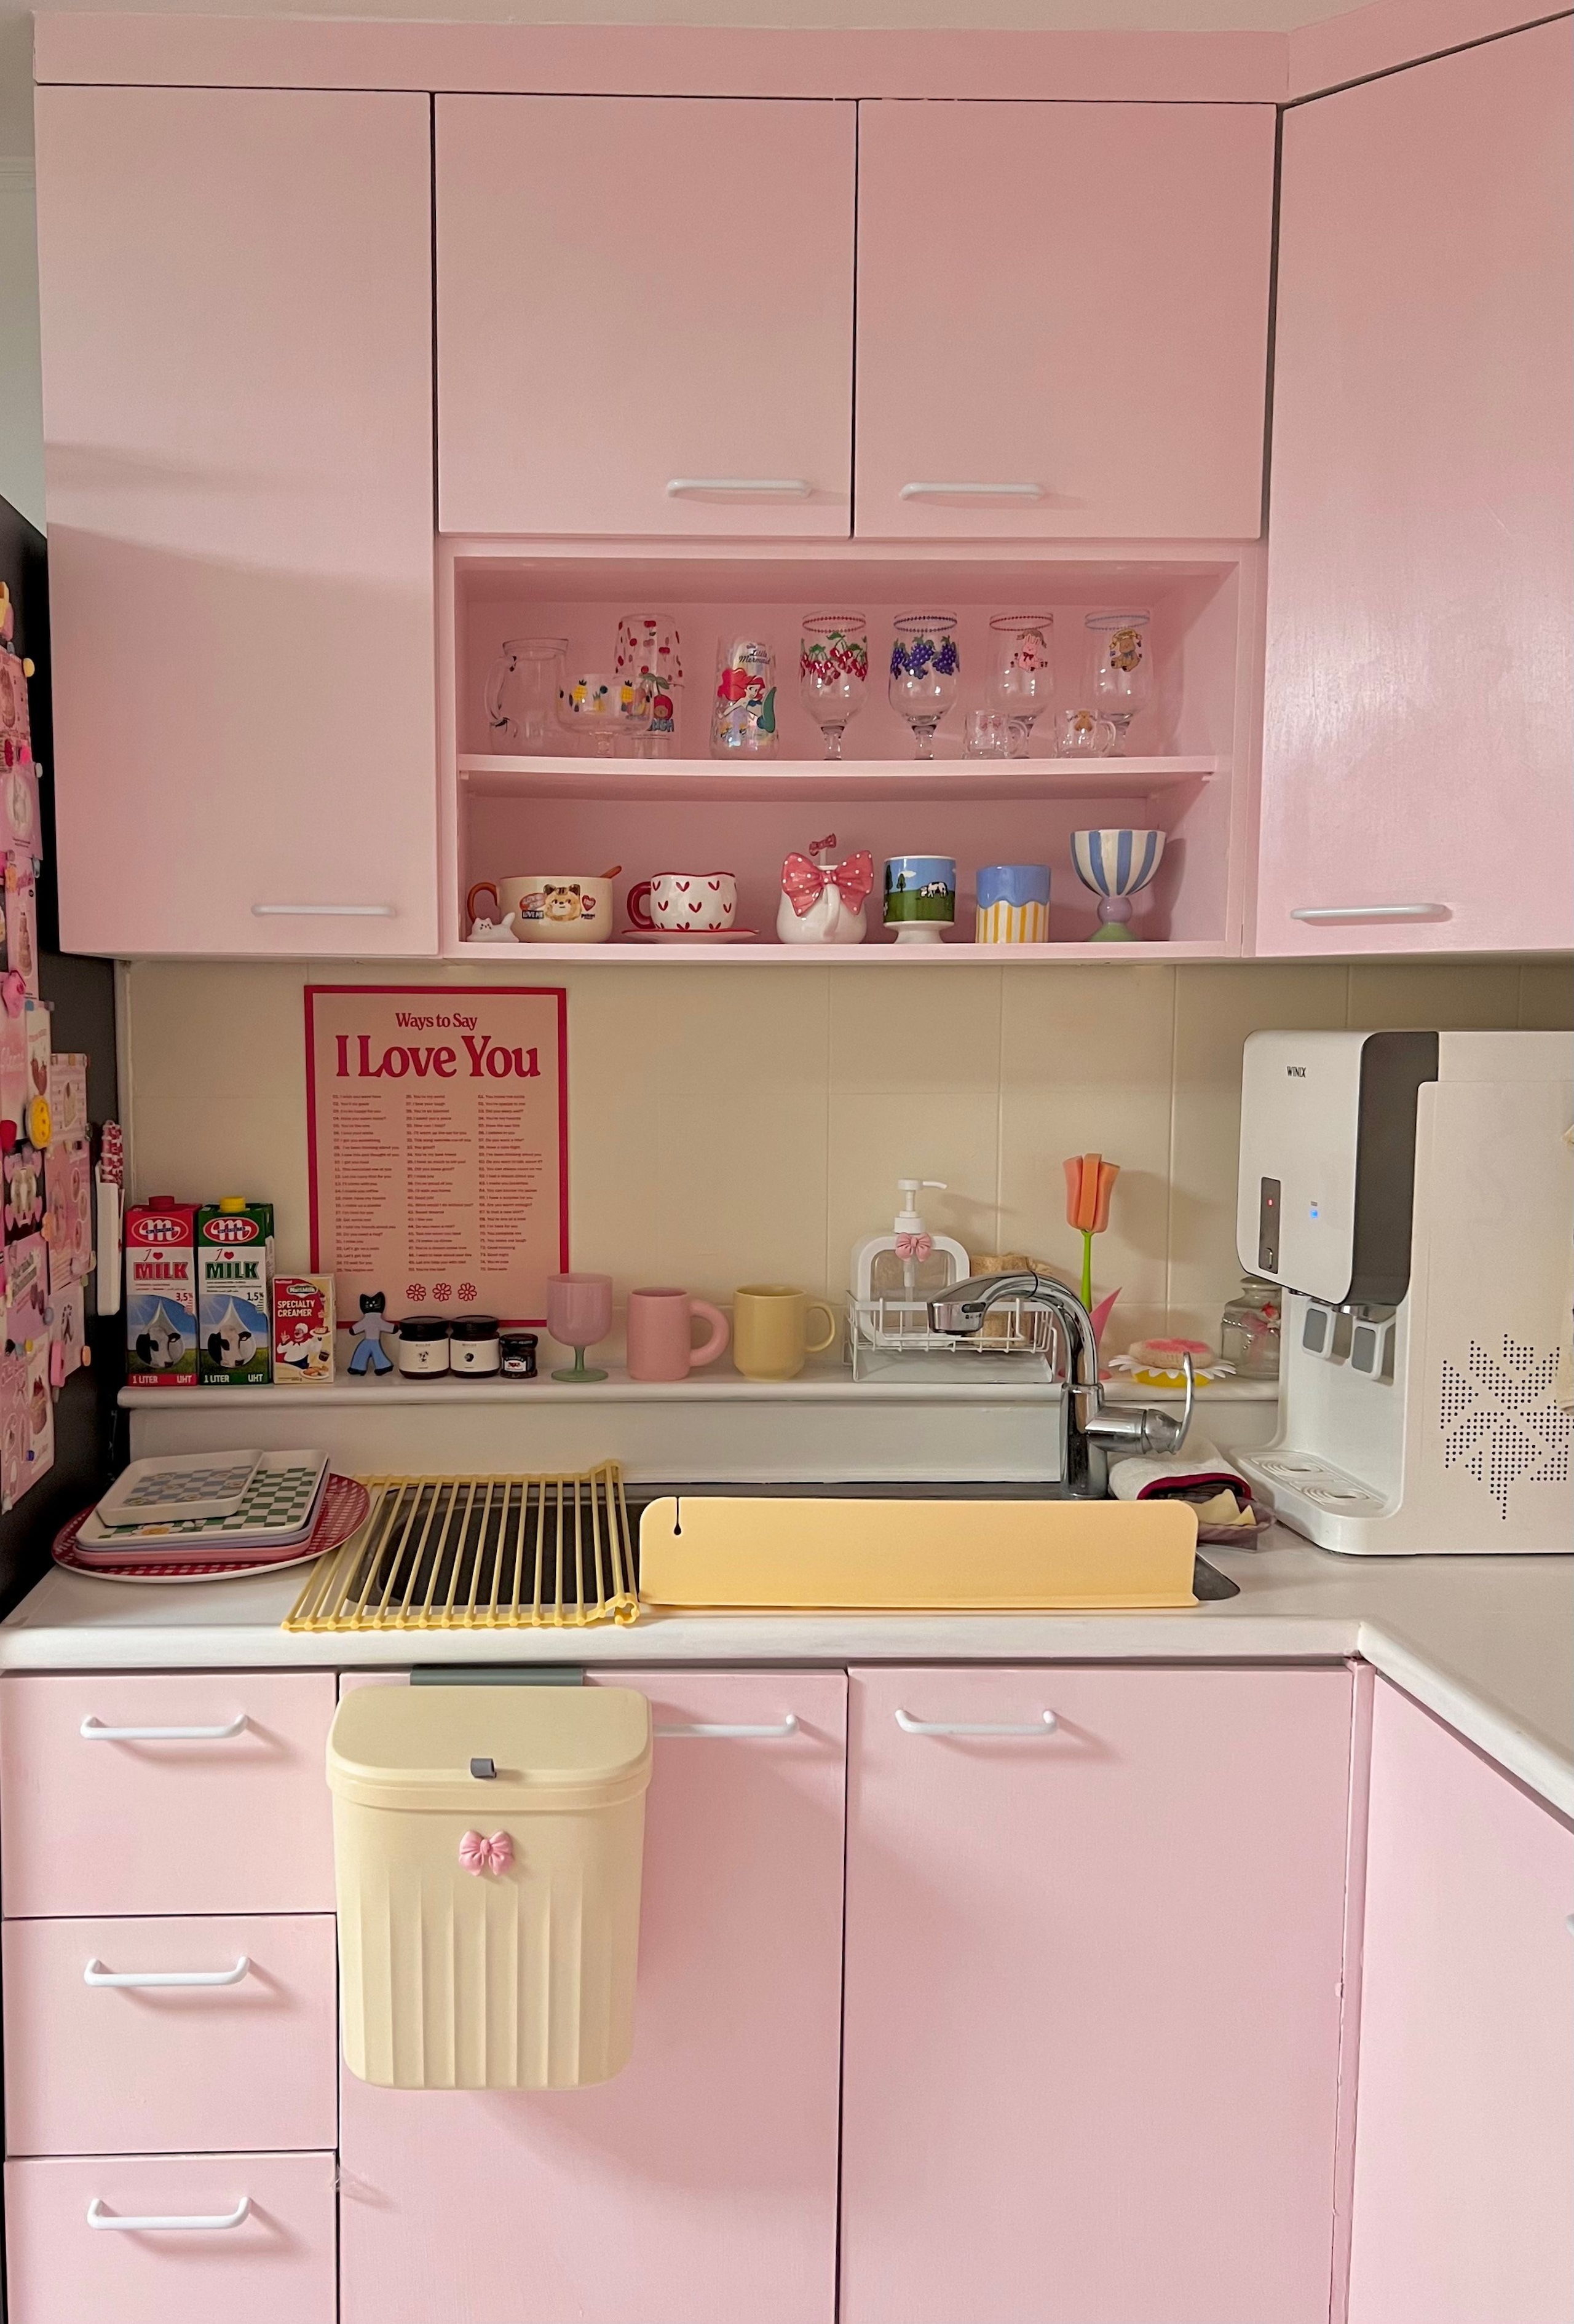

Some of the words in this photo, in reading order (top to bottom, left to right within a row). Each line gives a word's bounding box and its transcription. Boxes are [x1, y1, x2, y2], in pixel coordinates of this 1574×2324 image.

[395, 1012, 434, 1031] Ways
[436, 1014, 451, 1028] to
[453, 1013, 478, 1031] Say
[335, 1034, 350, 1077] I
[357, 1035, 457, 1078] Love
[461, 1035, 541, 1078] You
[1287, 1066, 1307, 1078] WINIX
[133, 1261, 189, 1281] MILK
[205, 1261, 259, 1280] MILK
[277, 1299, 315, 1309] SPECIALTY
[277, 1309, 312, 1318] CREAMER
[132, 1375, 137, 1384] 1
[138, 1375, 159, 1384] LITER
[176, 1374, 192, 1384] UHT
[204, 1374, 209, 1383] 1
[210, 1374, 230, 1383] LITER
[248, 1373, 264, 1382] UHT
